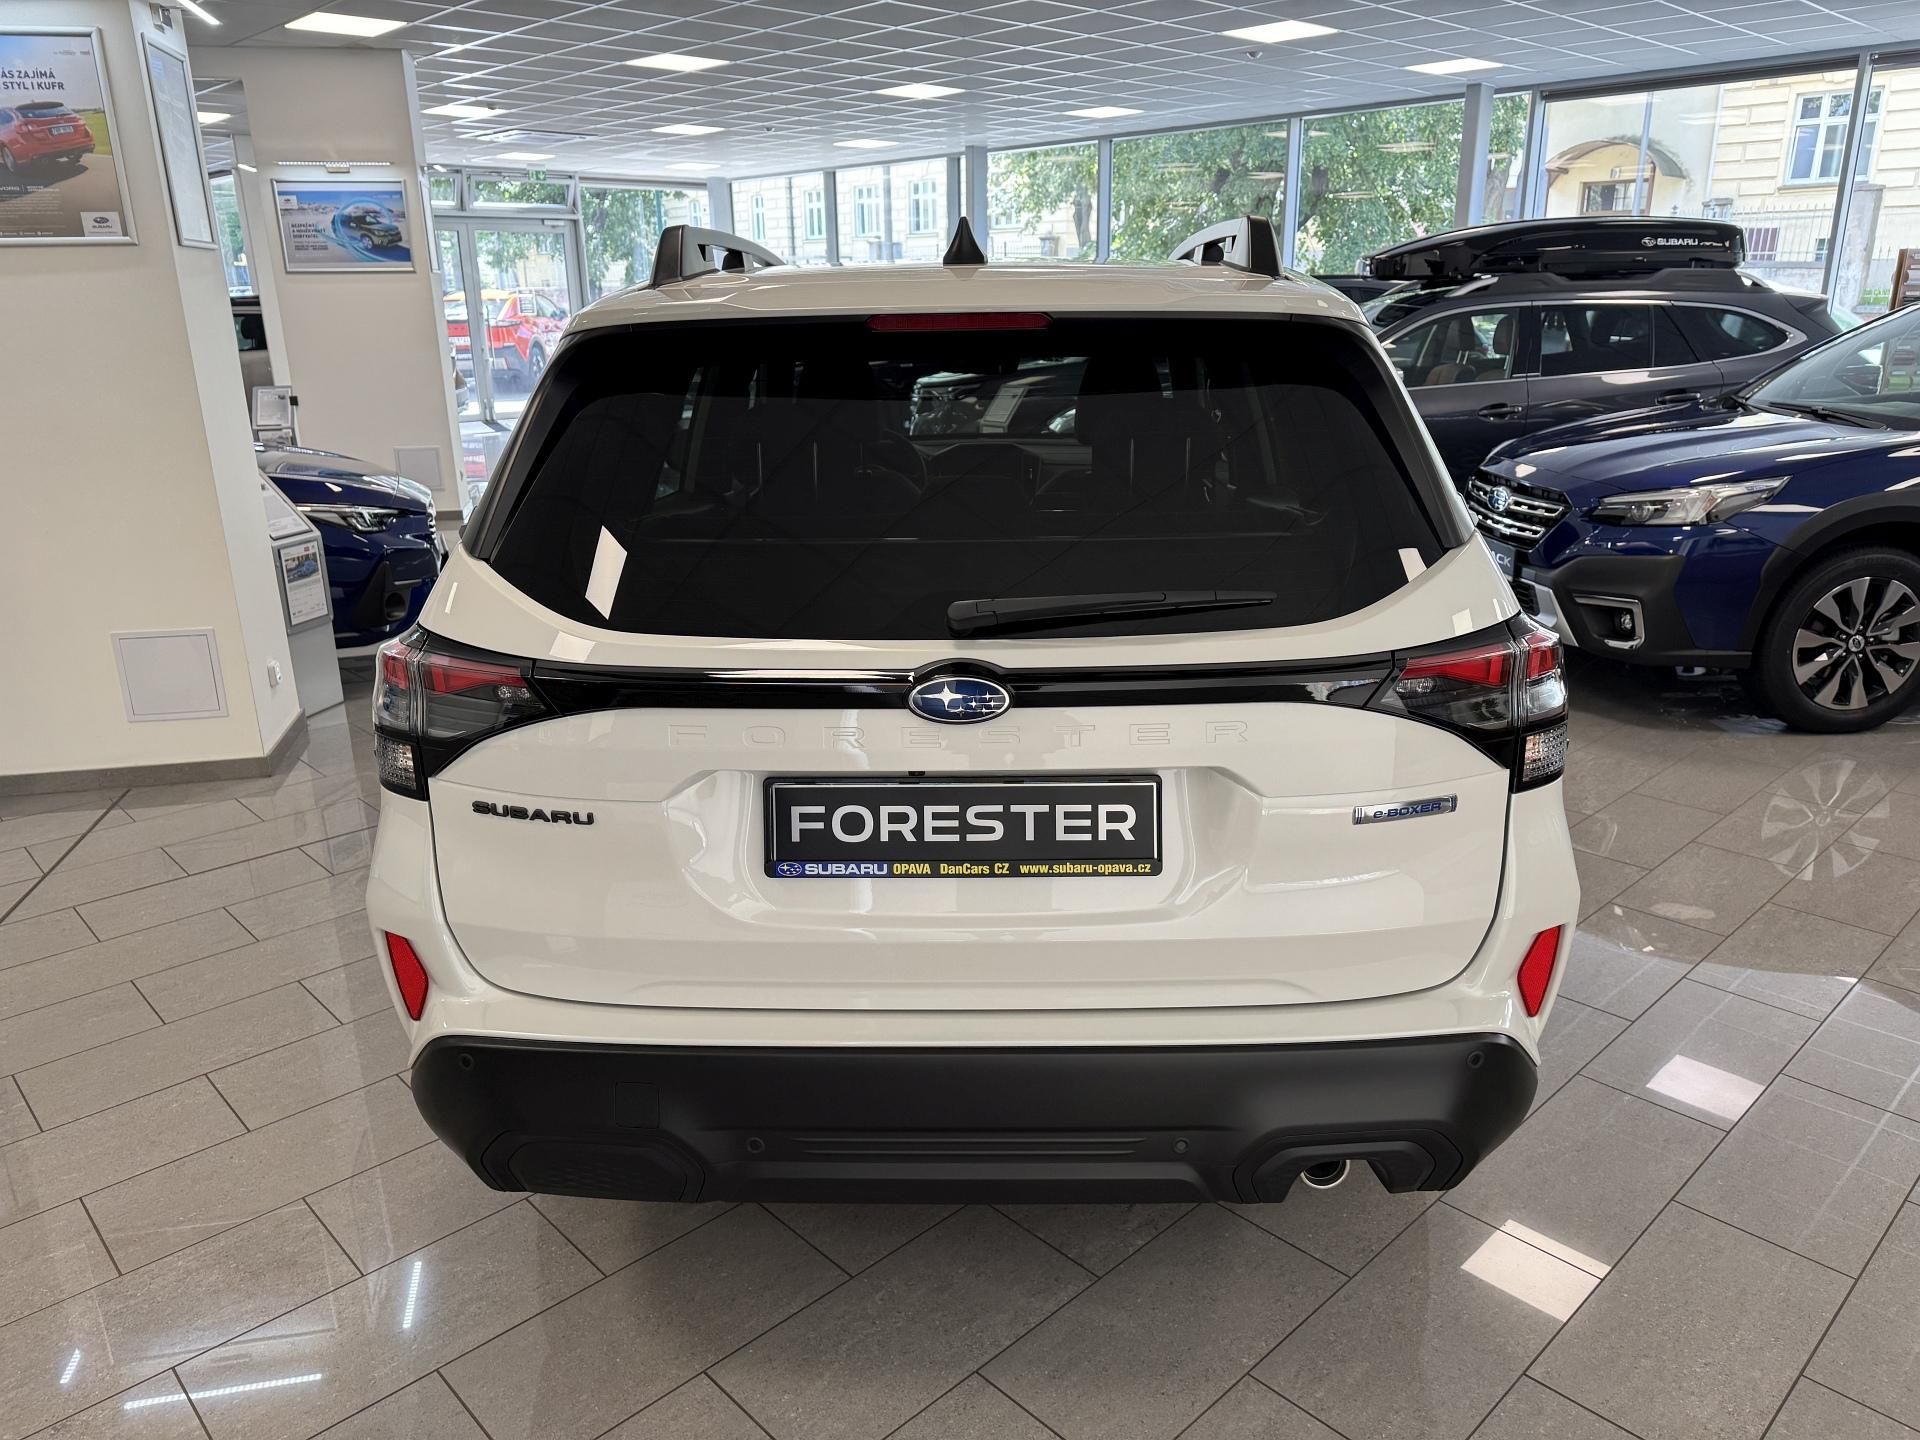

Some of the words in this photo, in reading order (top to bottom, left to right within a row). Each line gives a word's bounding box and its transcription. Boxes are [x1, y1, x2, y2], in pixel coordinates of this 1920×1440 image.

[17, 67, 56, 79] ZAJÍMÁ
[3, 81, 29, 90] STYL
[37, 81, 65, 90] KUFR
[1656, 238, 1699, 246] SUBARU
[668, 720, 1248, 750] FORESTER
[471, 800, 595, 826] SUBARU
[1373, 801, 1442, 819] e-BOXER
[790, 804, 1137, 843] FORESTER
[804, 863, 888, 875] SUBARU
[892, 863, 932, 875] OPAVA
[940, 863, 990, 875] DanCars
[994, 863, 1010, 875] CZ
[1019, 862, 1152, 876] www.subaru-opava.cz
